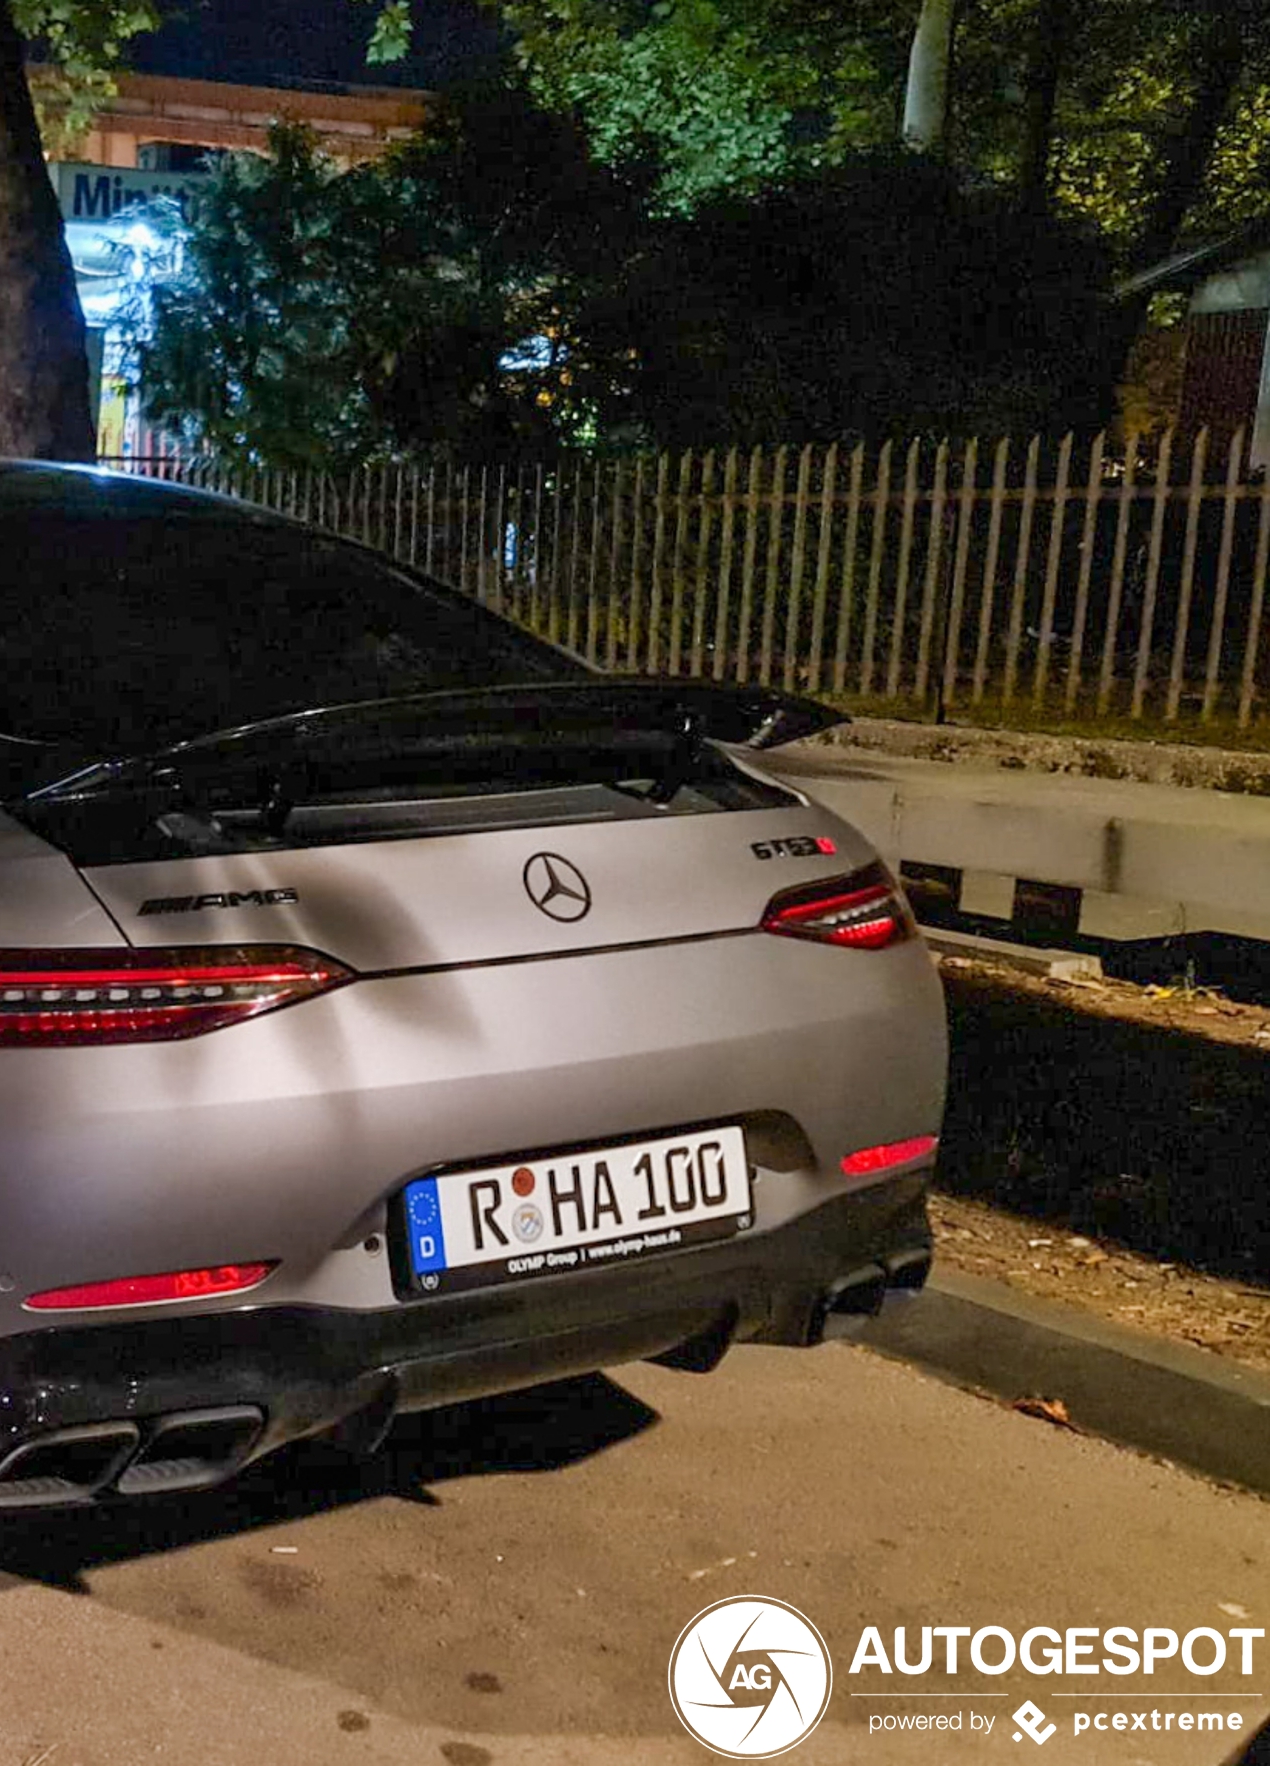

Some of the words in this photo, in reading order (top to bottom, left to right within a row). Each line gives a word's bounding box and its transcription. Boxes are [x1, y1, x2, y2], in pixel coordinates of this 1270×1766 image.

[193, 887, 298, 910] AMG
[468, 1178, 509, 1250] R
[547, 1161, 623, 1236] HA
[634, 1141, 728, 1221] 100
[420, 1236, 436, 1258] D
[507, 1255, 545, 1273] OLYMP
[546, 1250, 578, 1266] Group
